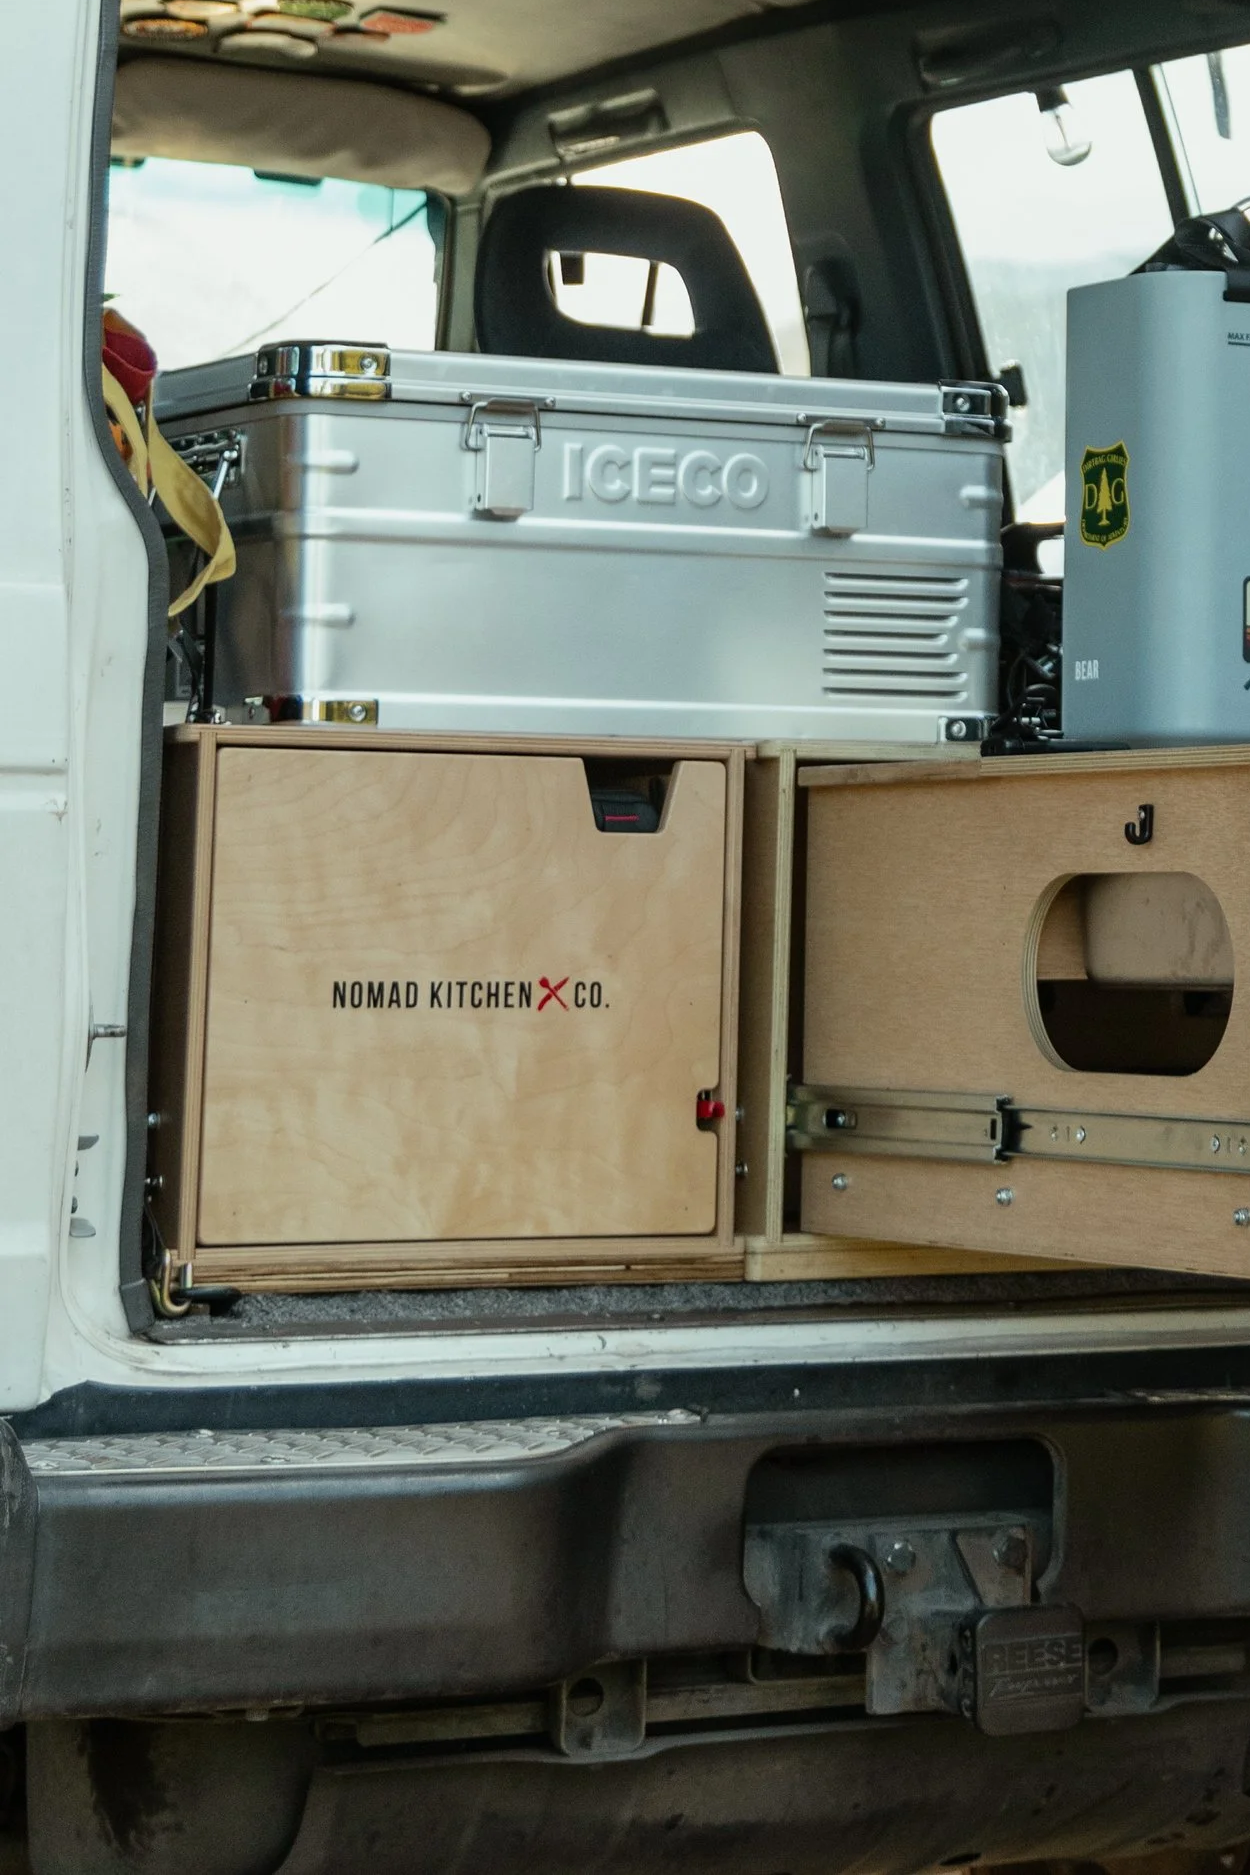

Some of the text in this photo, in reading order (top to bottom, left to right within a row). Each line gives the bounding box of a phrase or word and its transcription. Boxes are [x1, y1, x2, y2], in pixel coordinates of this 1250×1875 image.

[1227, 332, 1245, 341] MAX
[563, 442, 770, 509] ICECO
[1085, 483, 1098, 510] D
[1074, 659, 1099, 681] BEAR
[332, 980, 610, 1009] NOMAD KITCHEN CO.
[981, 1635, 1081, 1672] REESE
